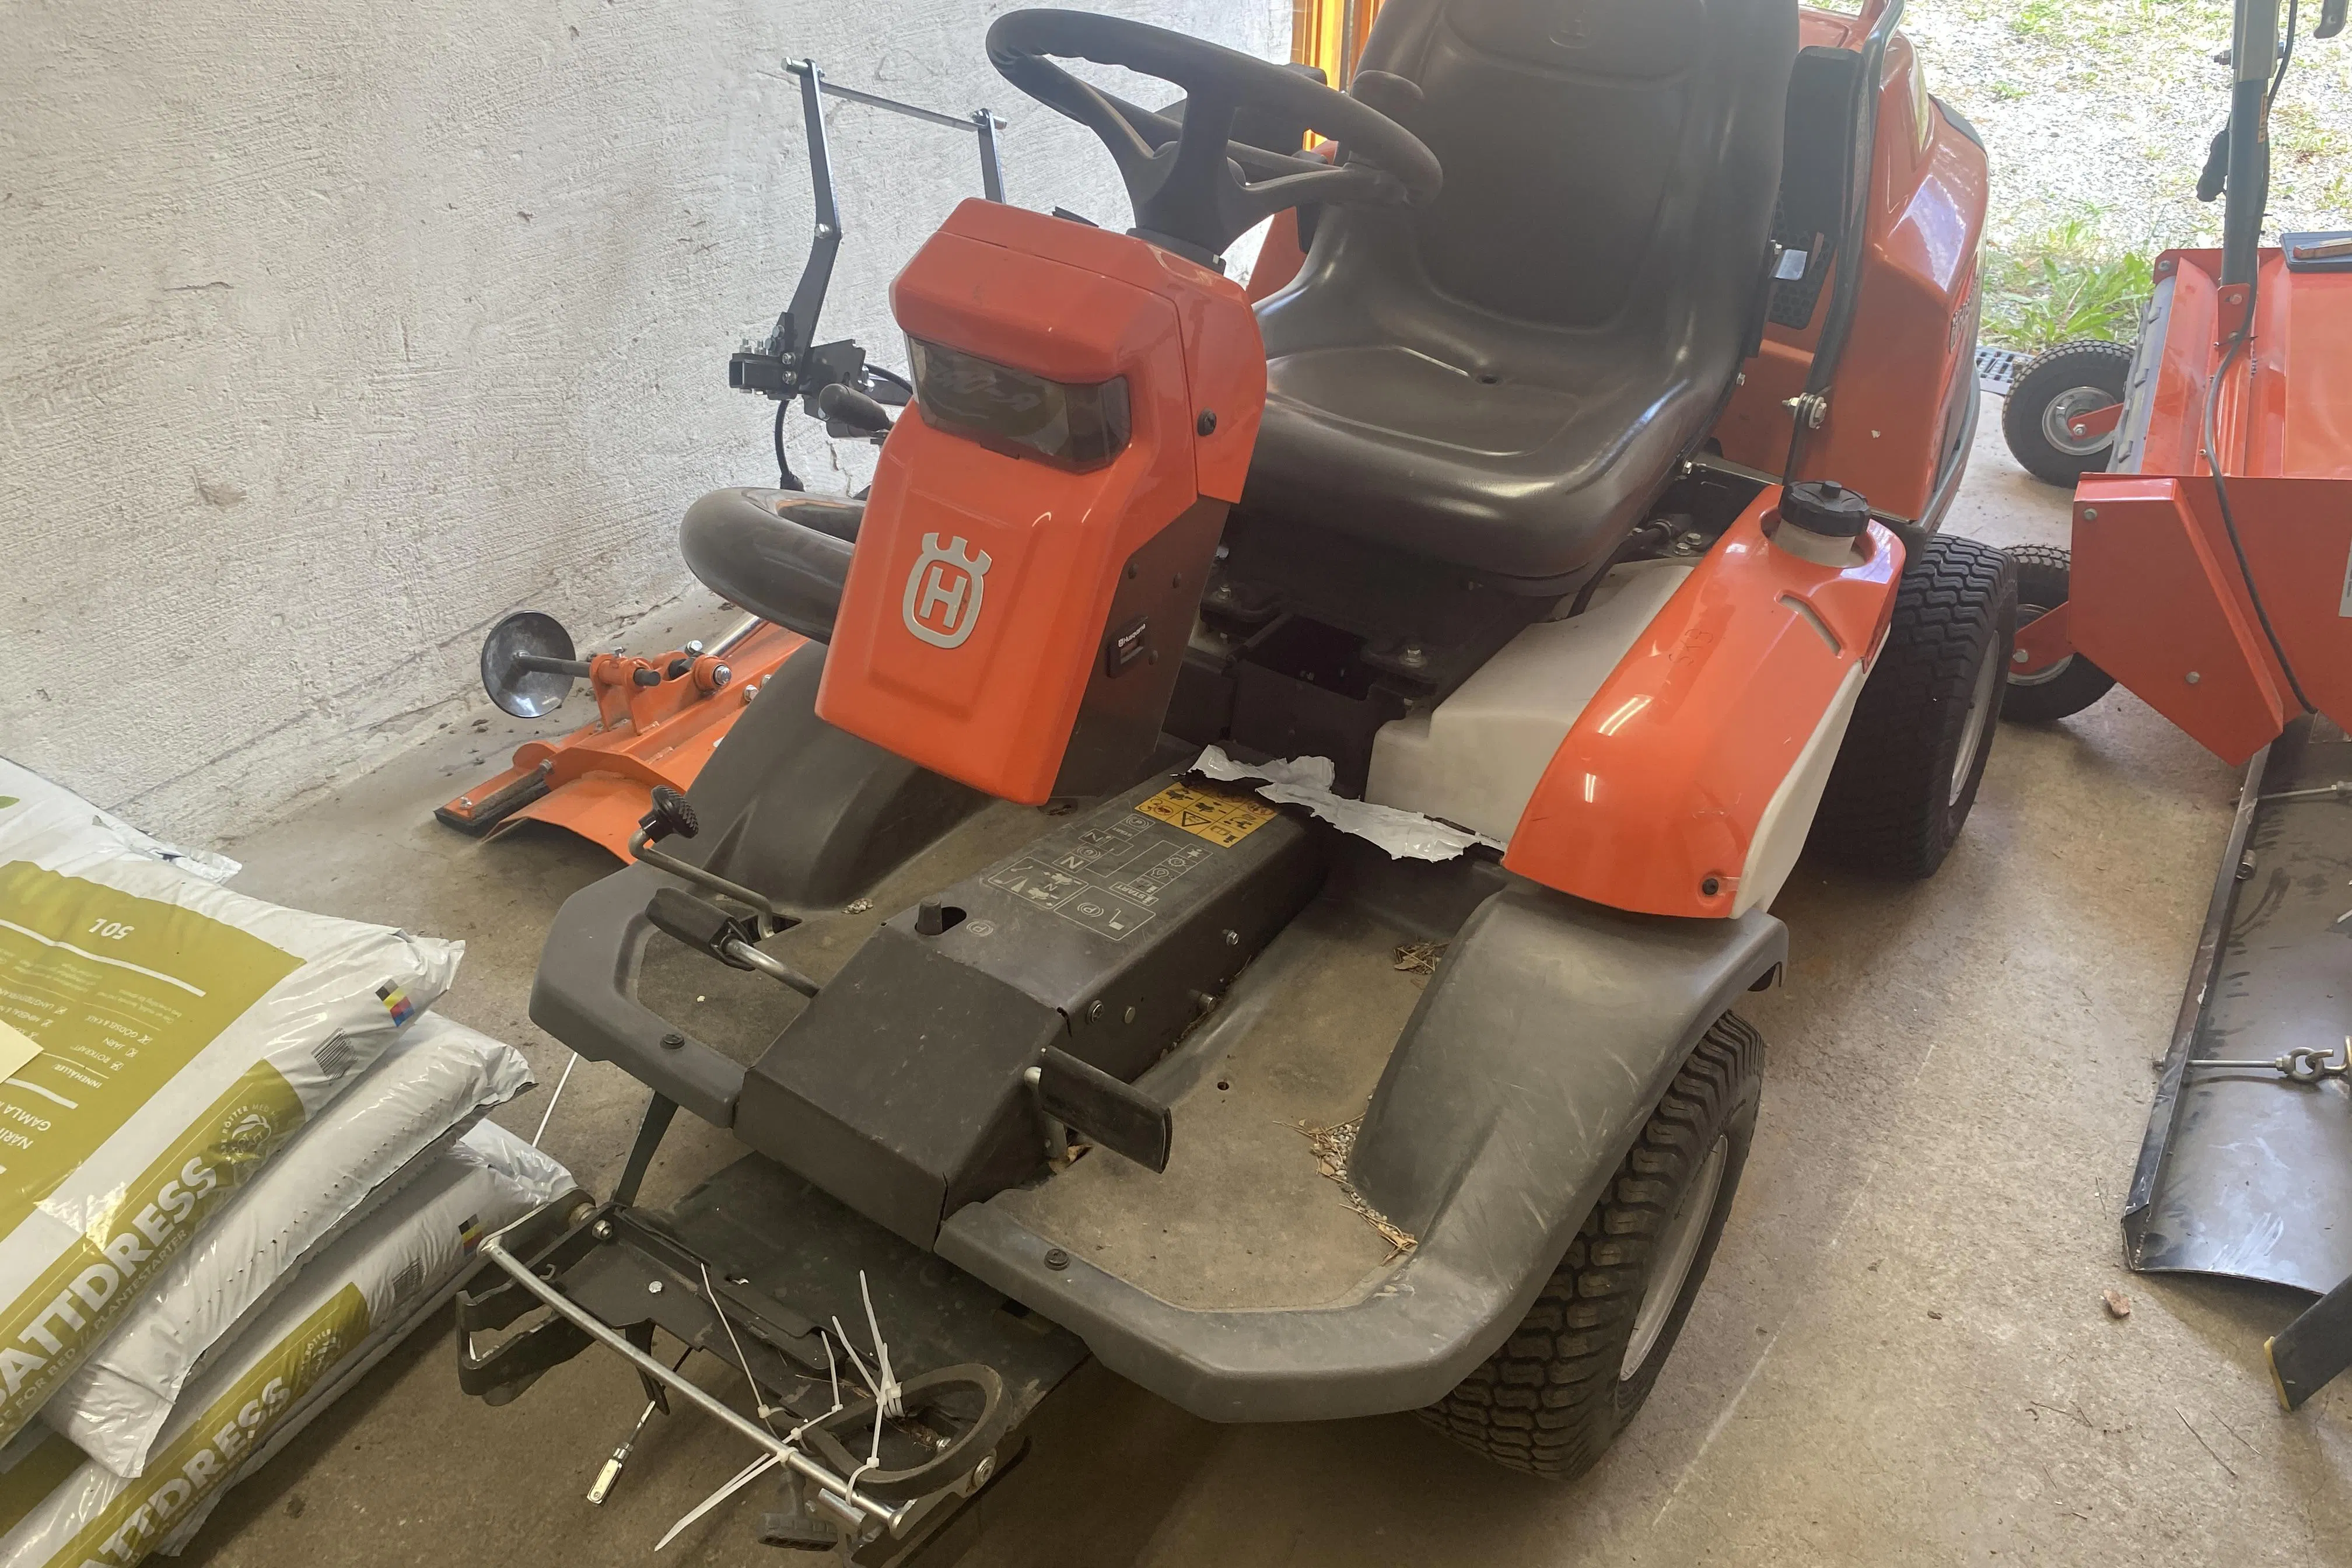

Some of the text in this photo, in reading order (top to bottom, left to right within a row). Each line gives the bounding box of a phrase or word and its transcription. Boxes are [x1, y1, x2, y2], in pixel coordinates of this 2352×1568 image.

[1060, 856, 1084, 869] N
[1115, 884, 1146, 900] START
[103, 1037, 125, 1051] JÄRN
[3, 1104, 51, 1132] GAMLA
[0, 1156, 218, 1408] ATTDRESS
[15, 1377, 47, 1409] FOR
[48, 1348, 76, 1376] BED
[94, 1228, 188, 1331] PLANTESTARTER
